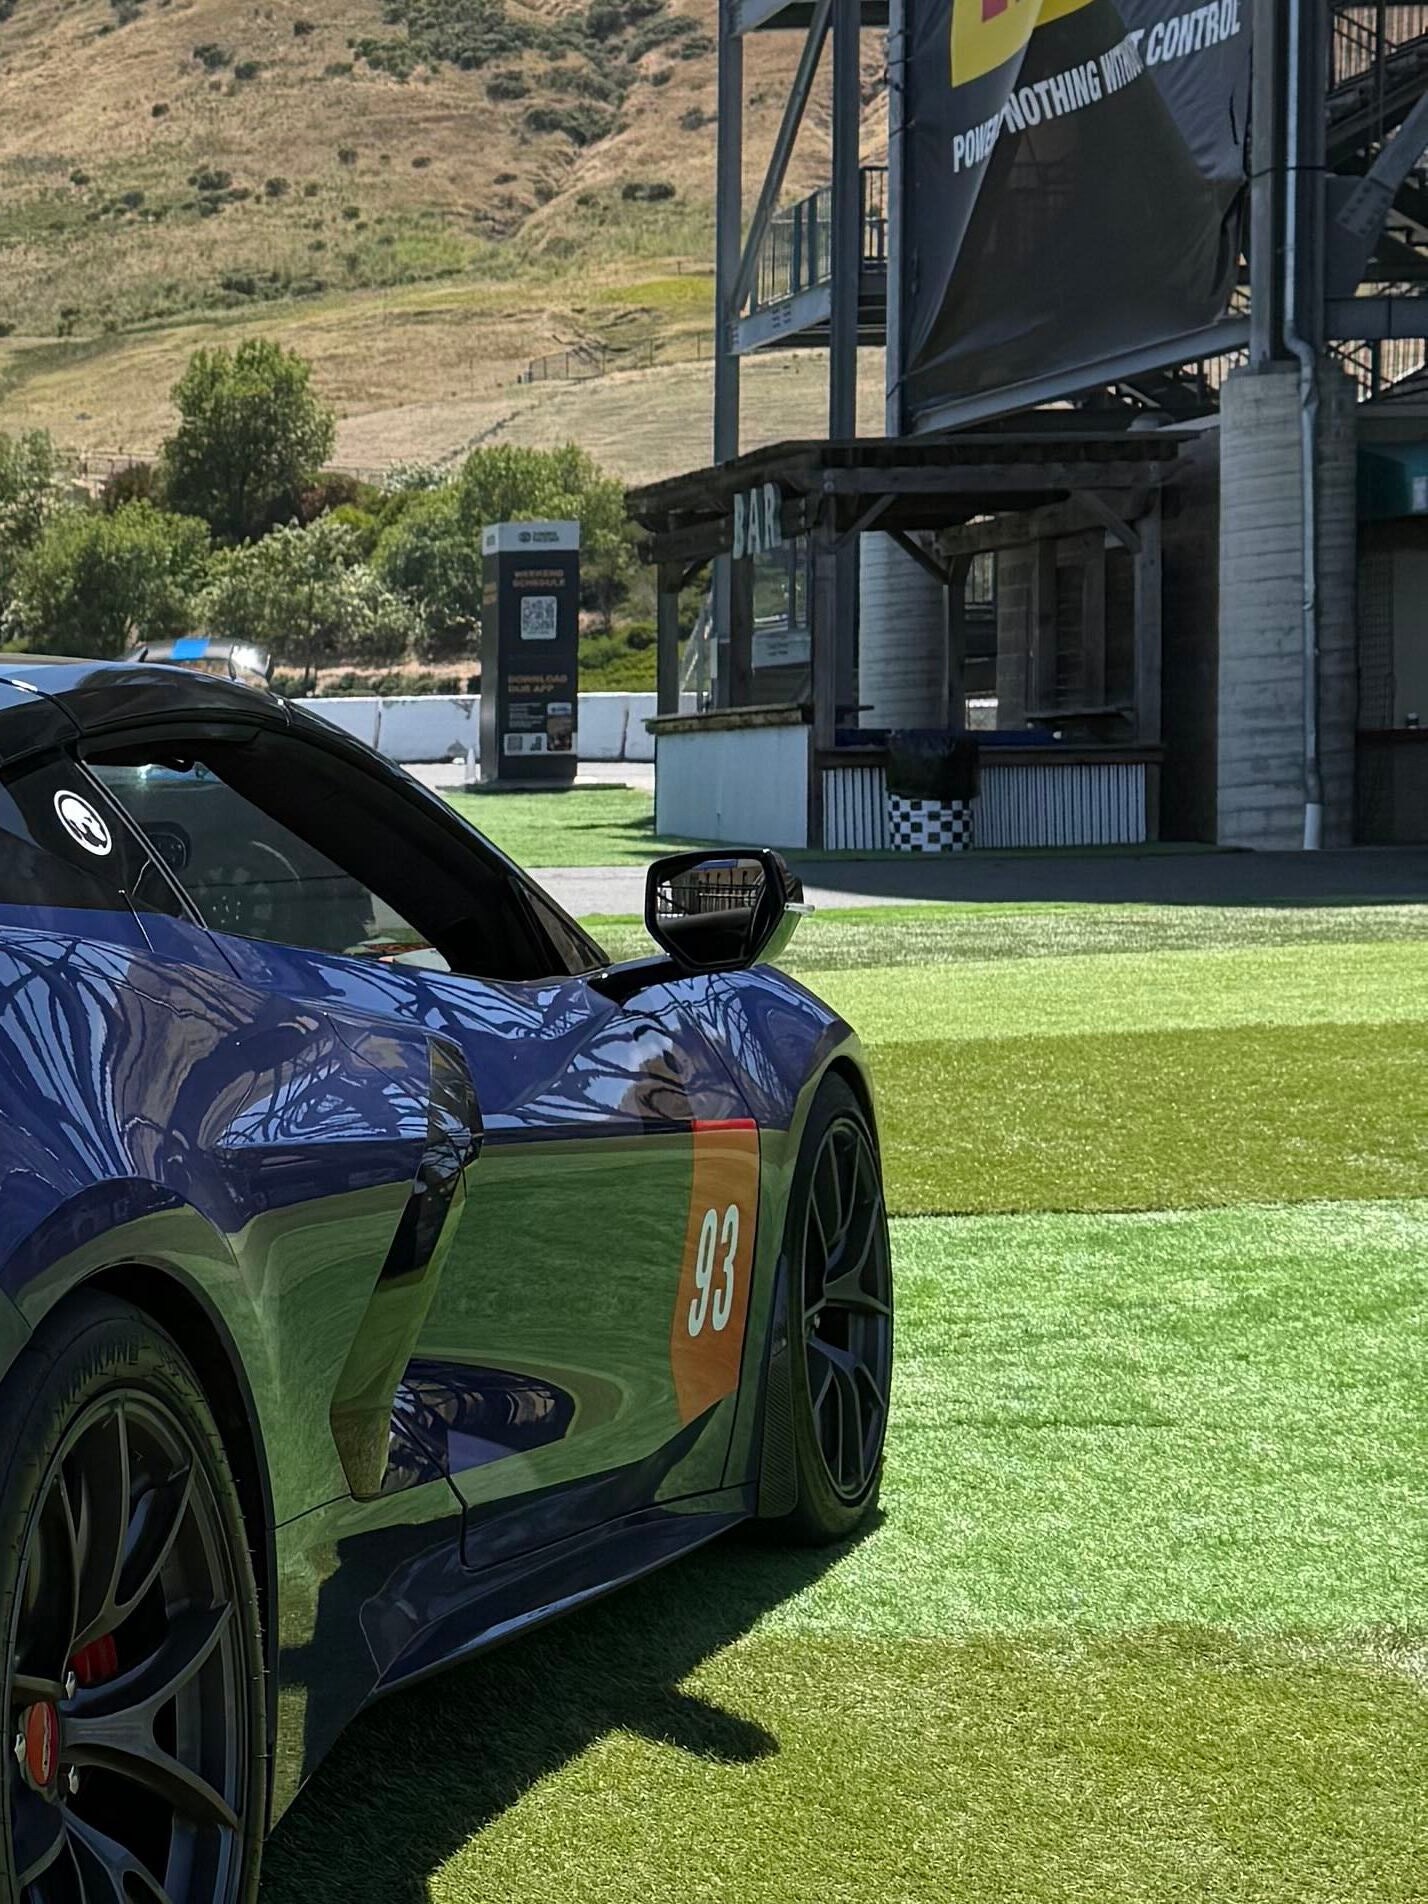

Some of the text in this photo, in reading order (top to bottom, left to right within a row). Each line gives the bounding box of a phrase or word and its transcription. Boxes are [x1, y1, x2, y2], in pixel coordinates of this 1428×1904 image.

[1002, 60, 1103, 134] NOTHING
[733, 483, 781, 559] BAR
[688, 1203, 739, 1337] 93
